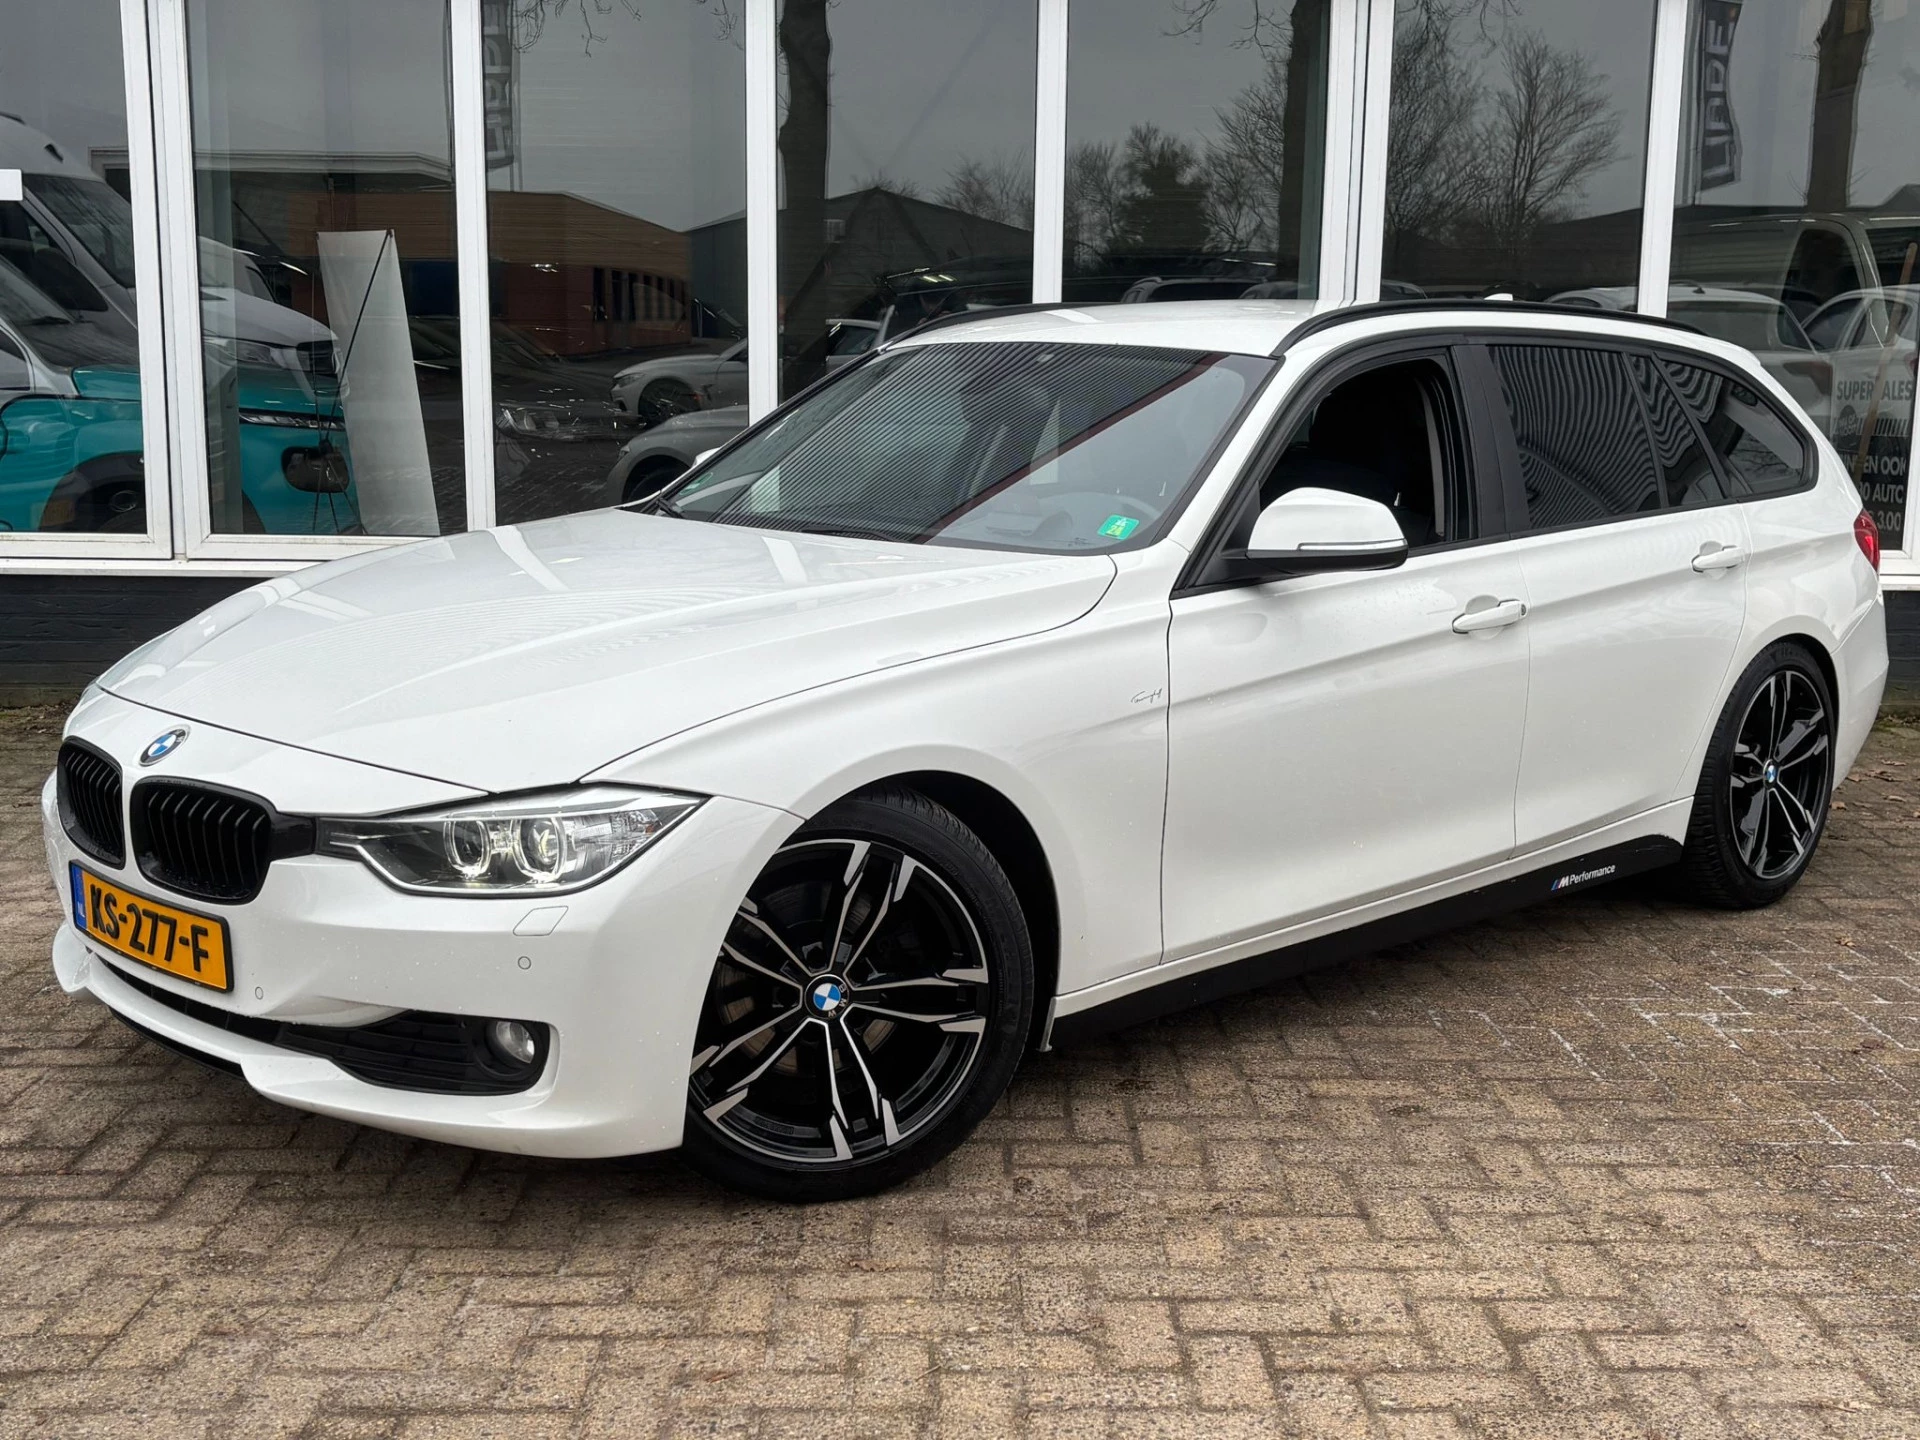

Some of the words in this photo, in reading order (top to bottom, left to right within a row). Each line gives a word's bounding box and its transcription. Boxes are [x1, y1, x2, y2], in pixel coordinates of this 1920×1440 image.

[1837, 380, 1912, 400] SUPERALES
[1569, 864, 1616, 885] Performance
[90, 883, 208, 972] KS-277-F
